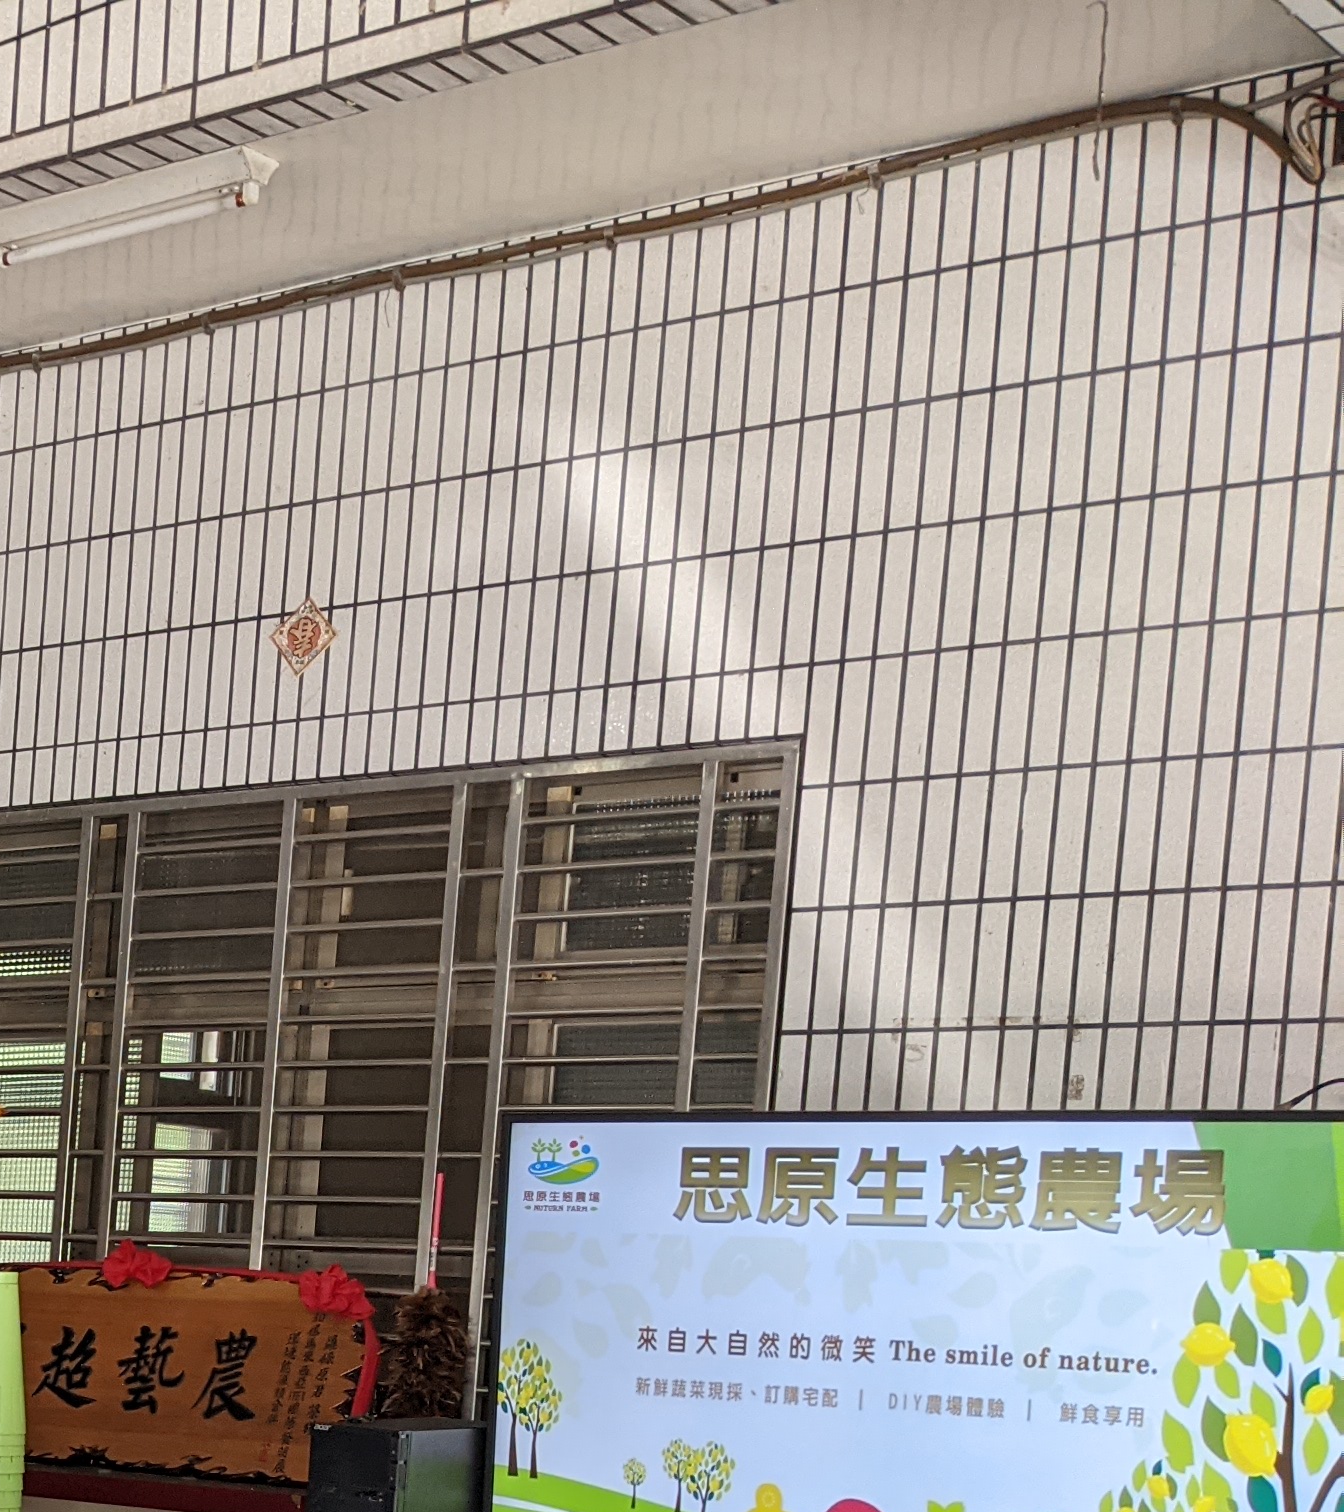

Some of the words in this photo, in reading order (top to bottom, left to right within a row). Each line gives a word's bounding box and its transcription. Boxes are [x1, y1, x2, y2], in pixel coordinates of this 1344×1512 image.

[672, 1144, 1226, 1237] 思原生態農場
[21, 1324, 259, 1421] 農藝超
[636, 1325, 877, 1364] 來自大自然的微笑
[888, 1340, 937, 1364] The
[945, 1345, 1014, 1367] smile
[1023, 1347, 1052, 1369] of
[1057, 1351, 1159, 1375] nature.
[635, 1376, 839, 1409] 新鮮蔬菜現採、訂購宅配
[888, 1392, 1006, 1419] DIY農場體驗
[1059, 1402, 1146, 1428] 鮮食享用
